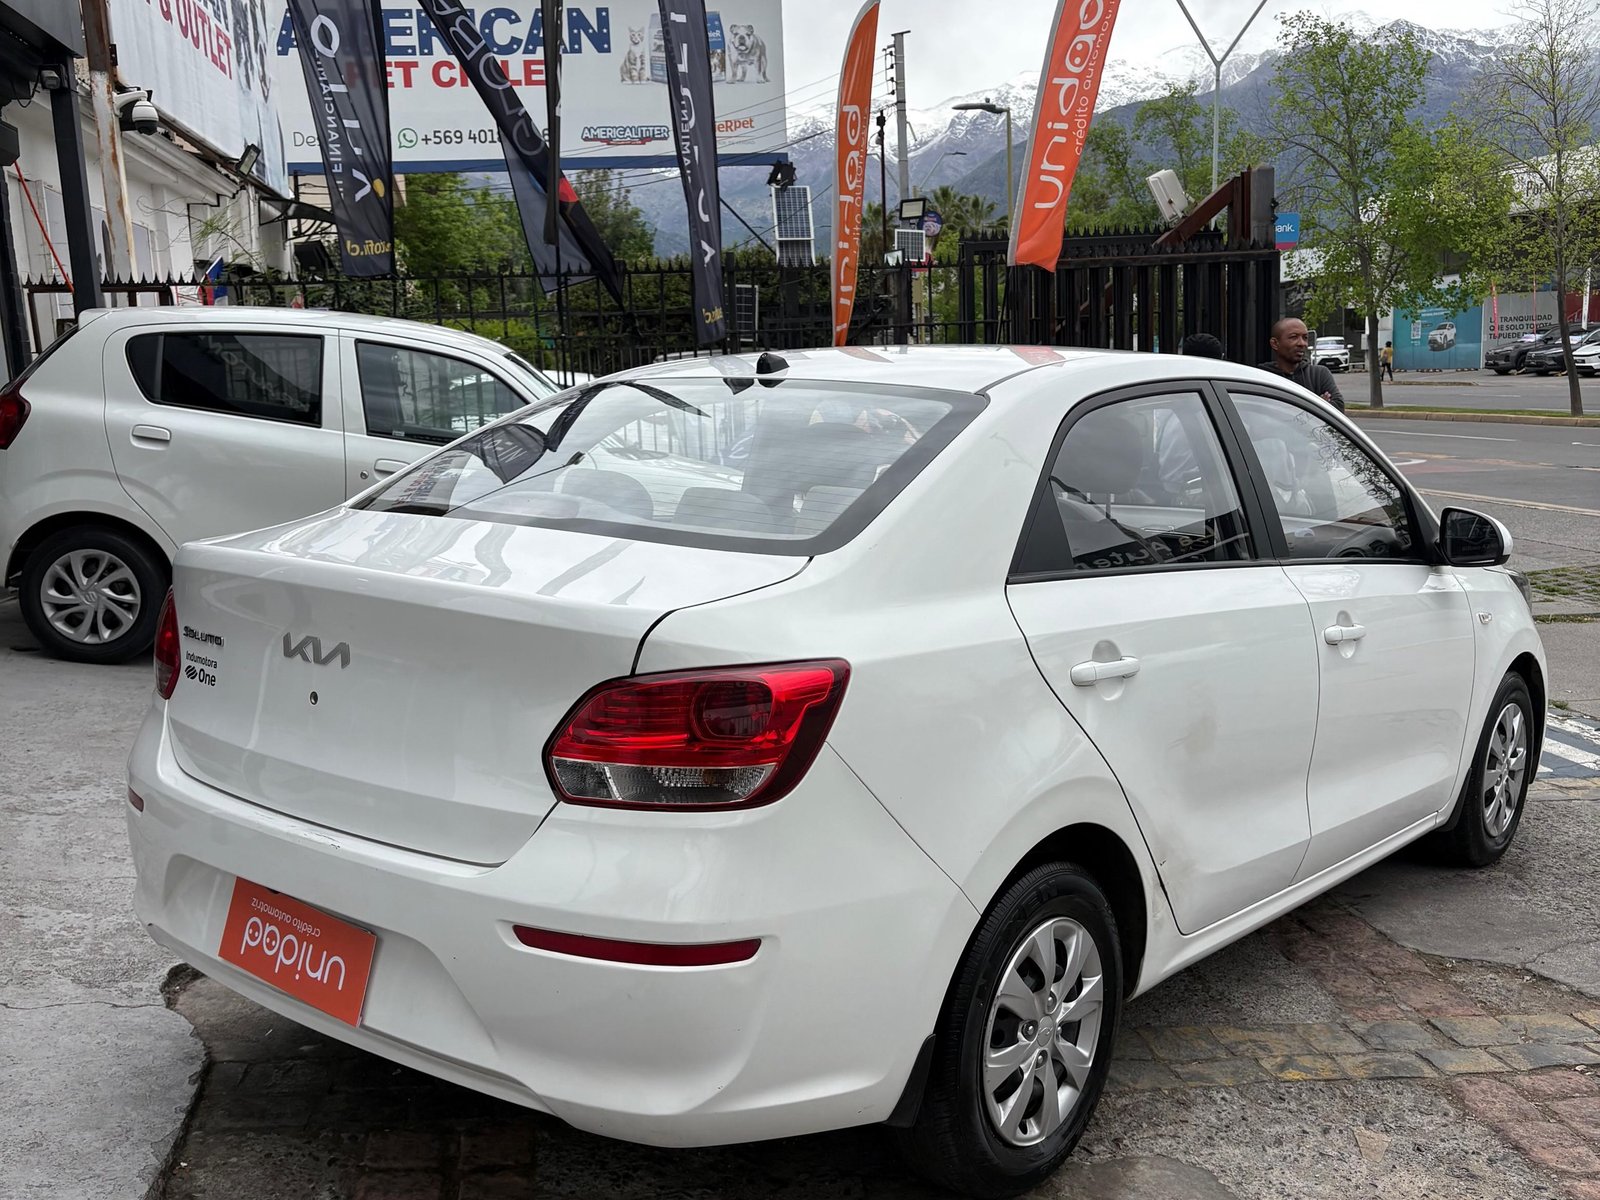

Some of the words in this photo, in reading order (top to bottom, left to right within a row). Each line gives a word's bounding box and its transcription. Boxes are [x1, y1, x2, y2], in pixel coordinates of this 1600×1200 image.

[176, 0, 232, 80] OUTLET
[277, 7, 611, 56] ERCAN
[431, 60, 547, 88] CLE
[582, 126, 669, 139] AMERICALITTER
[714, 117, 755, 133] eRpet
[1072, 96, 1089, 155] crédito
[421, 130, 463, 145] +569
[468, 129, 500, 144] 401
[1500, 313, 1553, 323] TRANQUILDAD
[183, 625, 225, 647] SOLUTO
[185, 650, 218, 669] Indumotora
[198, 668, 217, 687] One
[251, 897, 292, 924] automotriz
[292, 916, 321, 938] crédito
[240, 916, 346, 991] unidad
